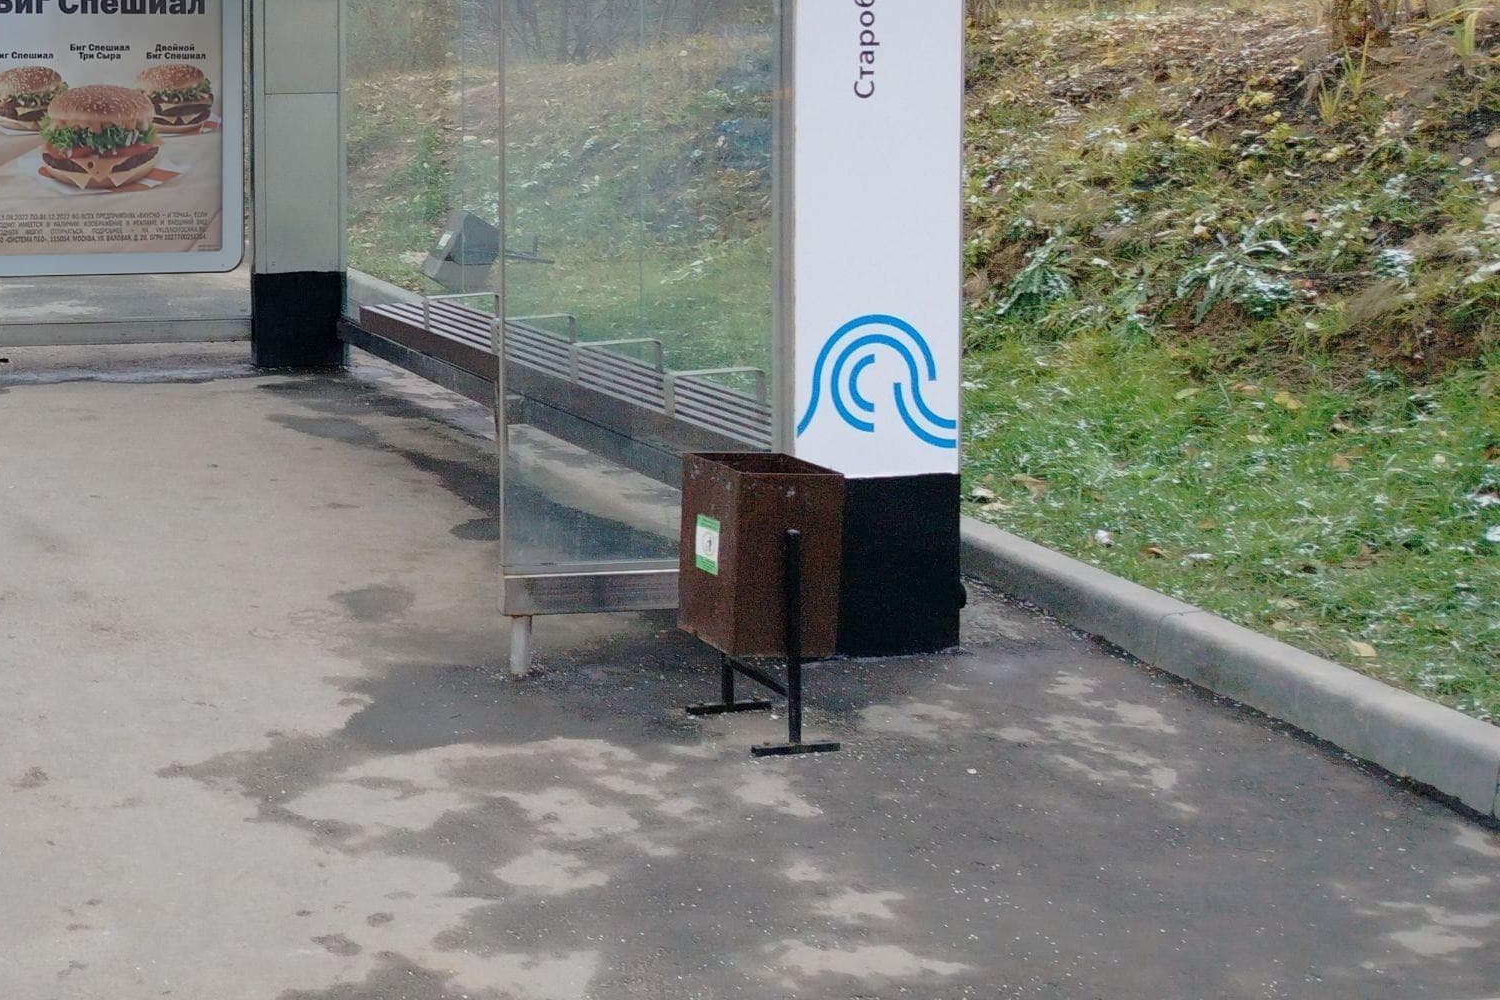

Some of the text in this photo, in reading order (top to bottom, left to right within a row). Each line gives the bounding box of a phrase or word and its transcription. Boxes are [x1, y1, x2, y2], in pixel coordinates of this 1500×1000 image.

[69, 43, 131, 51] Биг Спешиал
[155, 43, 195, 52] Двойной
[11, 51, 54, 60] Спешиал
[78, 51, 121, 61] Три Сыра
[146, 51, 207, 60] Биг Спешиал
